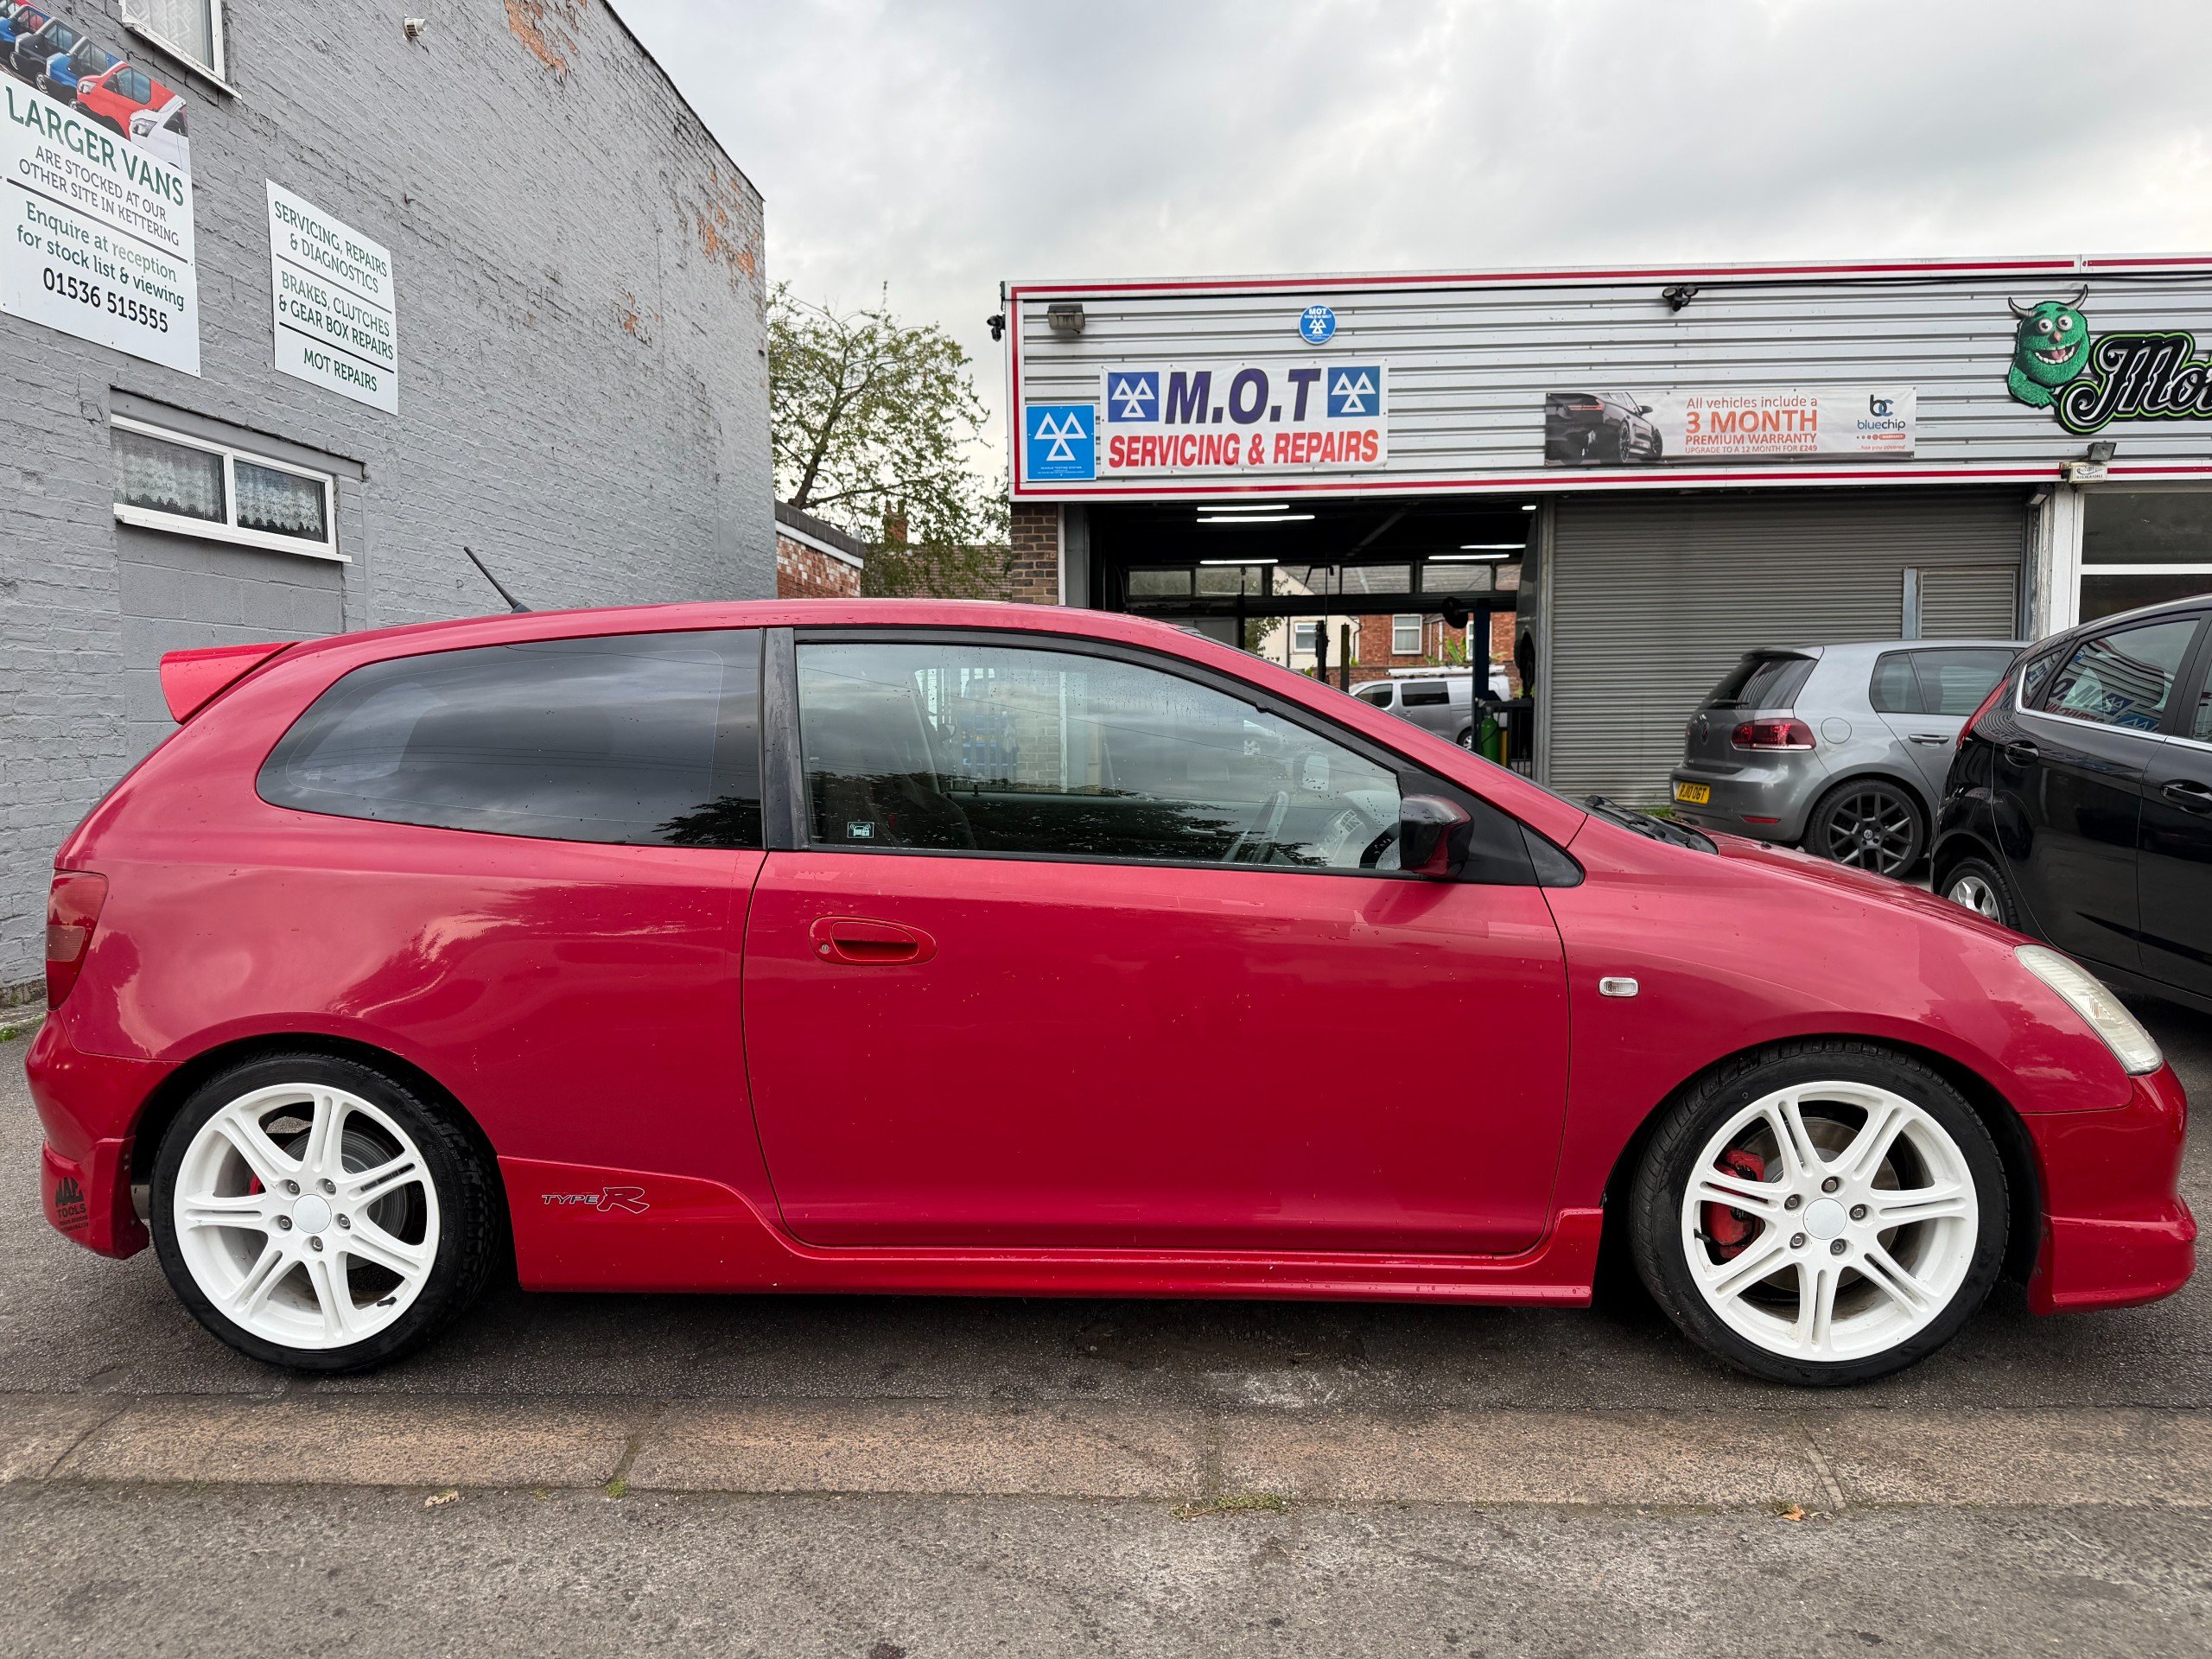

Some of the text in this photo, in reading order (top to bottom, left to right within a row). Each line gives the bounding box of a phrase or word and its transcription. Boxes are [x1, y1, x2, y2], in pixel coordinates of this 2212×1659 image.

[5, 86, 184, 207] LARGER VANS
[19, 158, 179, 246] OTHER SITE IN KETTERING
[35, 145, 167, 222] ARE STOCKED AT OUR
[17, 225, 184, 312] for stock list & viewing
[26, 200, 177, 283] Enquire at reception
[274, 200, 387, 277] SERVICING, REPAIRS
[290, 232, 378, 294] & DIAGNOSTICS
[43, 267, 168, 333] 01536 515555
[278, 294, 394, 360] & GEAR BOX REPAIRS
[281, 270, 390, 337] BRAKES, CLUTCHES
[303, 347, 378, 391] MOT REPAIRS
[1165, 368, 1321, 425] M.O.T
[2064, 338, 2212, 427] Mo
[1686, 410, 1817, 434] 3 MONTH
[1687, 396, 1818, 409] All vehicles include a
[1857, 419, 1906, 431] bluechip
[1109, 429, 1379, 467] SERVICING & REPAIRS
[1686, 433, 1817, 445] PREMIUM WARRANTY
[57, 1204, 86, 1219] TOOLS
[542, 1186, 650, 1214] TYPE R
